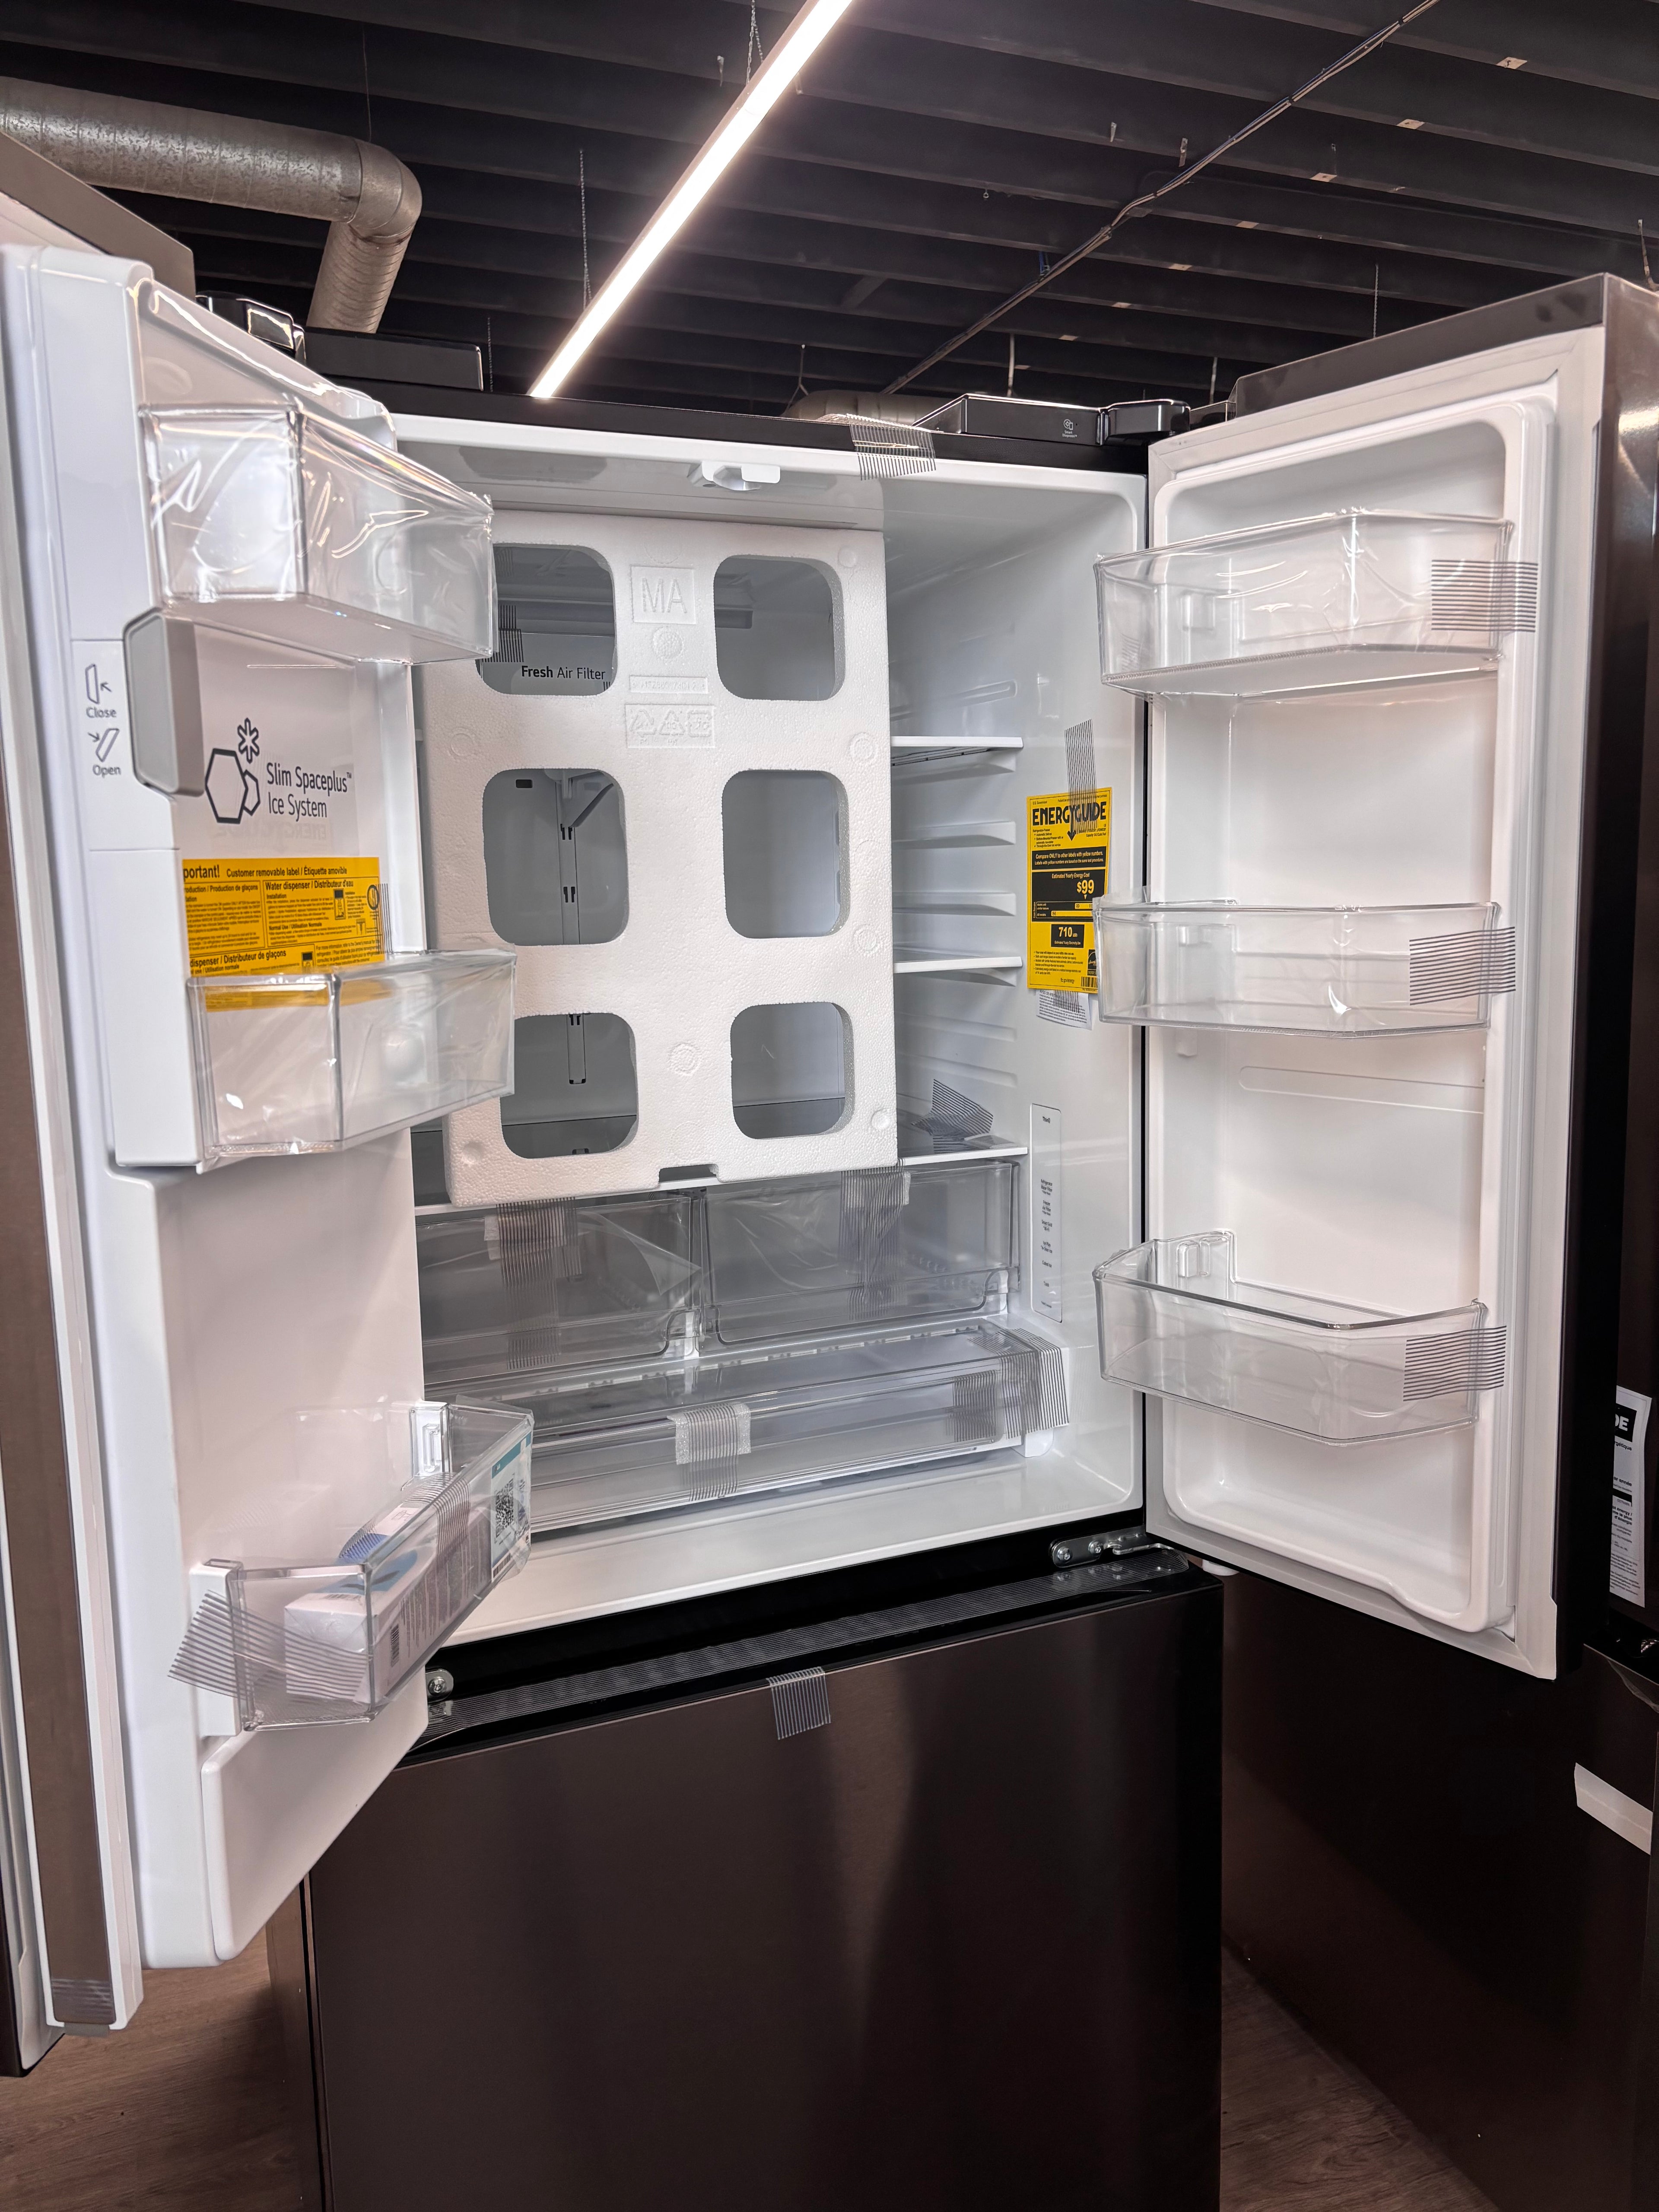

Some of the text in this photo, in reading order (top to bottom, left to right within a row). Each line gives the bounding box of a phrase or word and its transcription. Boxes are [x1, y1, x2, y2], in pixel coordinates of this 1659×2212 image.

[642, 578, 687, 613] MA
[521, 665, 606, 680] Fresh Air Filter
[86, 707, 117, 718] Close
[92, 764, 121, 779] Open
[267, 762, 292, 786] Slim
[268, 791, 327, 822] Ice System
[227, 868, 254, 877] Customer
[256, 868, 285, 877] removable
[286, 867, 300, 876] label
[304, 865, 327, 877] Étiquette
[328, 866, 347, 875] amovible
[242, 884, 258, 893] glaçons
[265, 882, 281, 890] Water
[283, 881, 310, 891] dispenser
[315, 880, 342, 889] Distributeur
[1077, 879, 1094, 894] $99
[1058, 927, 1072, 938] 710
[190, 956, 219, 968] dispenser
[224, 953, 257, 964] Distributeur
[266, 950, 286, 960] glaçons
